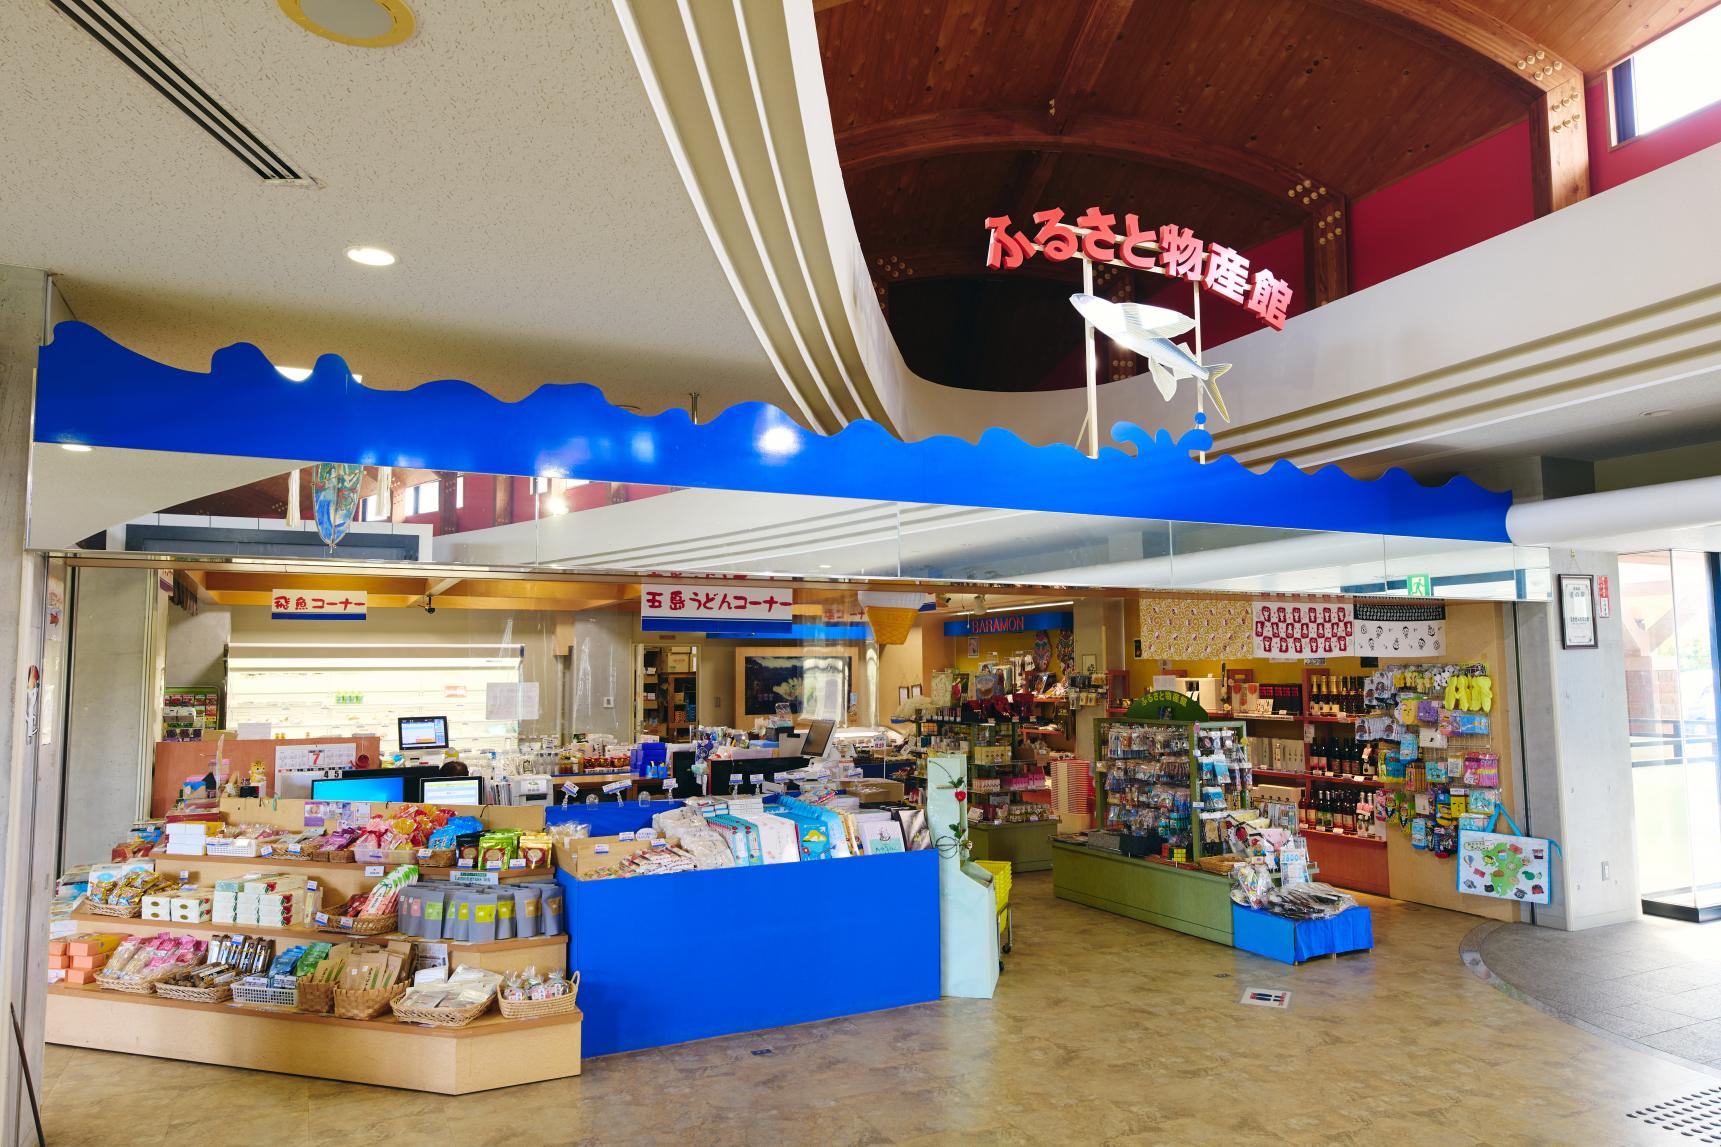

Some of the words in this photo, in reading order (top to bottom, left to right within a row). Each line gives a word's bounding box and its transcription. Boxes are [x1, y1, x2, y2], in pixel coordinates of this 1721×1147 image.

[985, 207, 1293, 331] ふるさと物産館
[274, 595, 365, 611] 飛魚コーナー
[645, 590, 792, 612] 五島うどんコーナー
[972, 616, 1024, 633] BARAMON
[313, 752, 320, 765] 7
